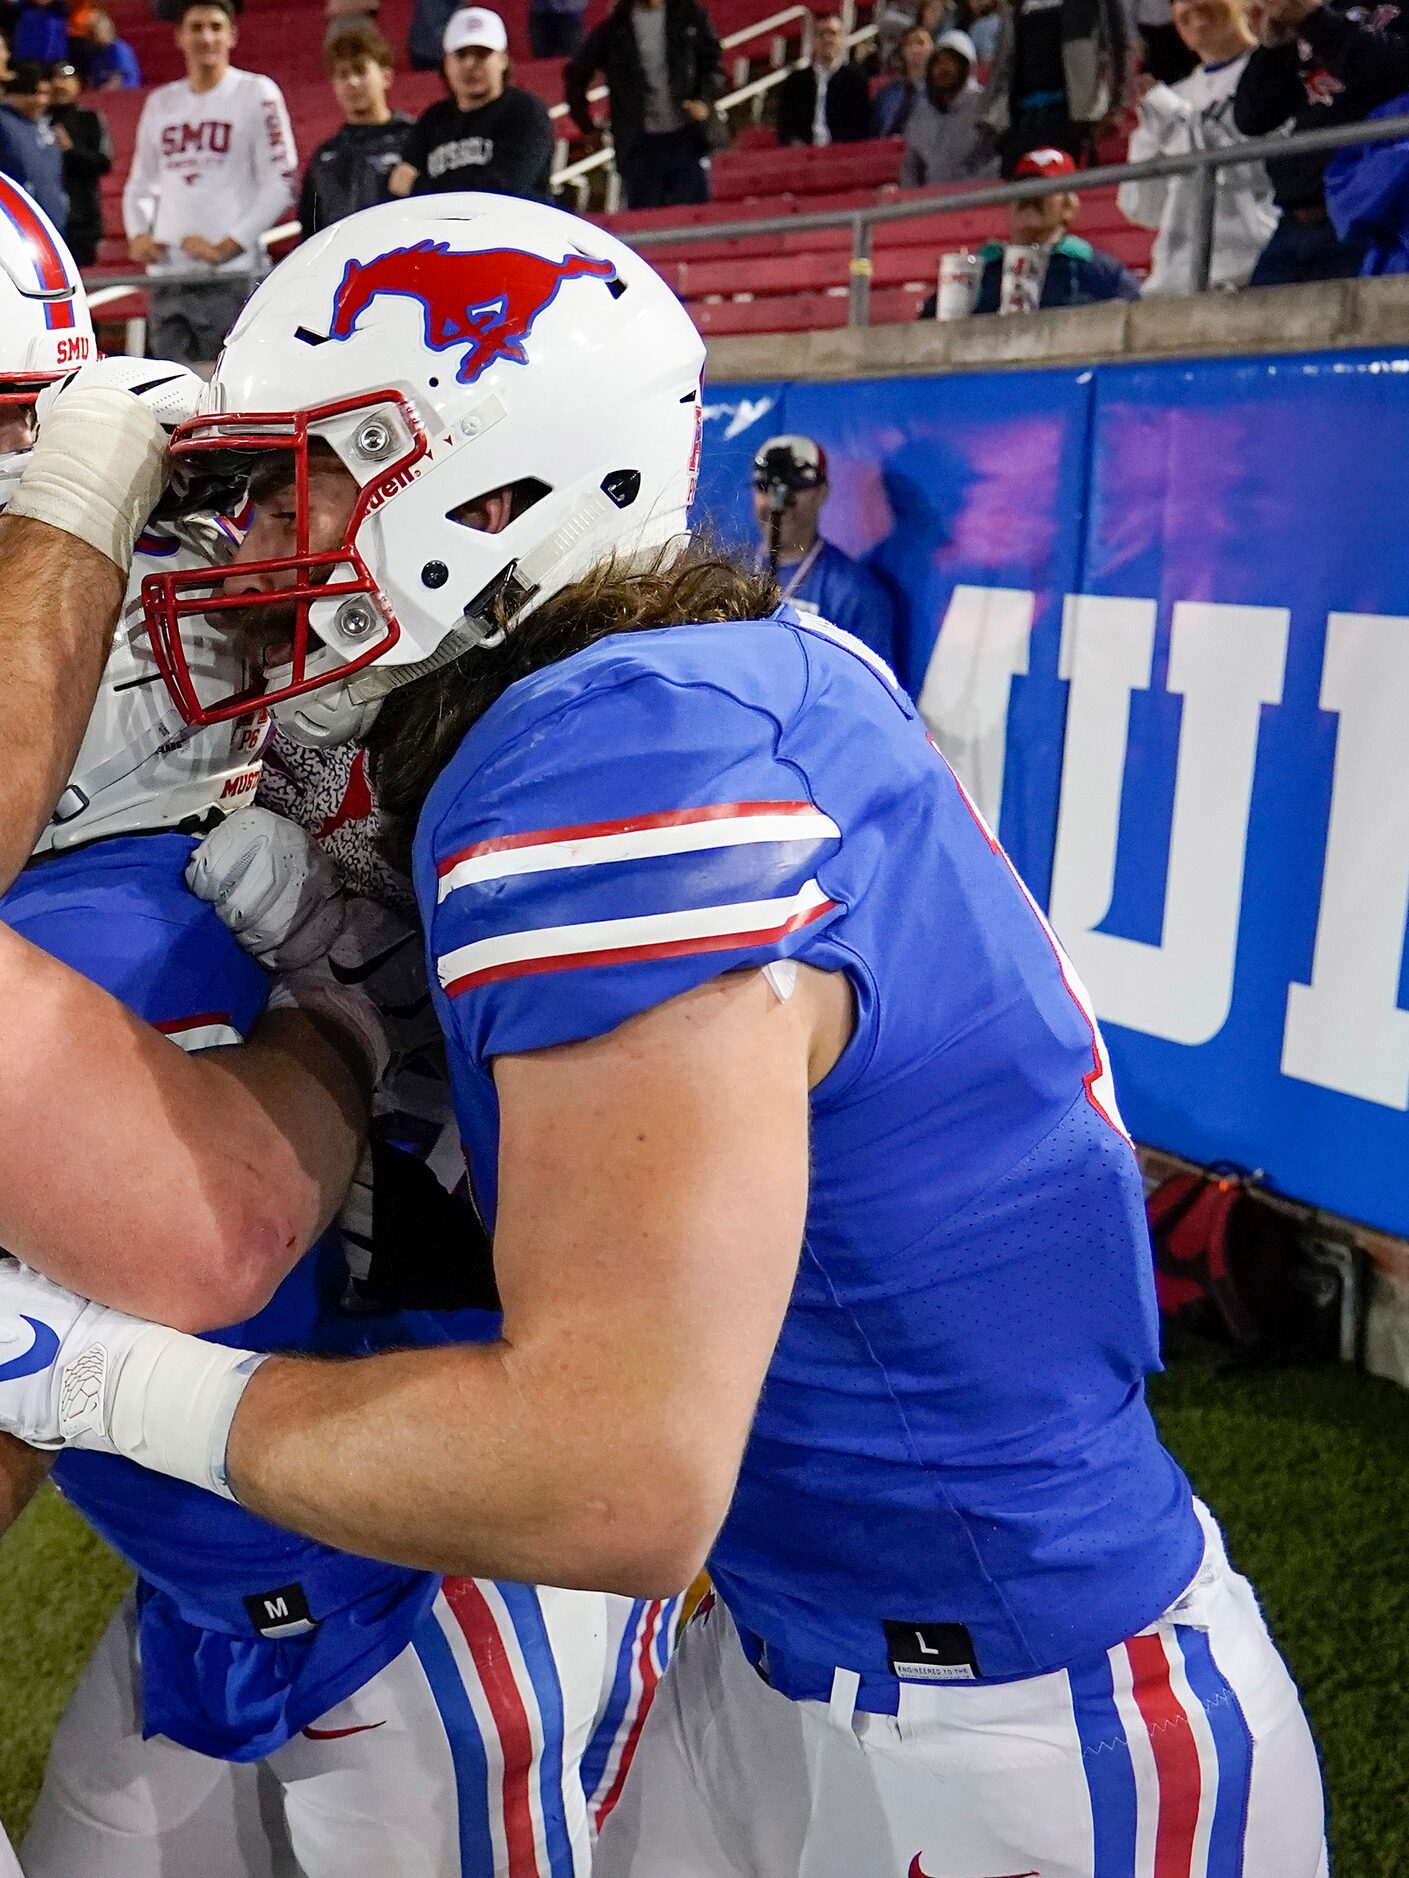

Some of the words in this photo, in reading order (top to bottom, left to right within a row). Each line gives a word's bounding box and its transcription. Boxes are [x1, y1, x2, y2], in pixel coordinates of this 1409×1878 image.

[161, 121, 233, 156] SMU
[56, 336, 89, 365] SMU
[263, 1596, 289, 1620] M
[915, 1631, 939, 1655] L
